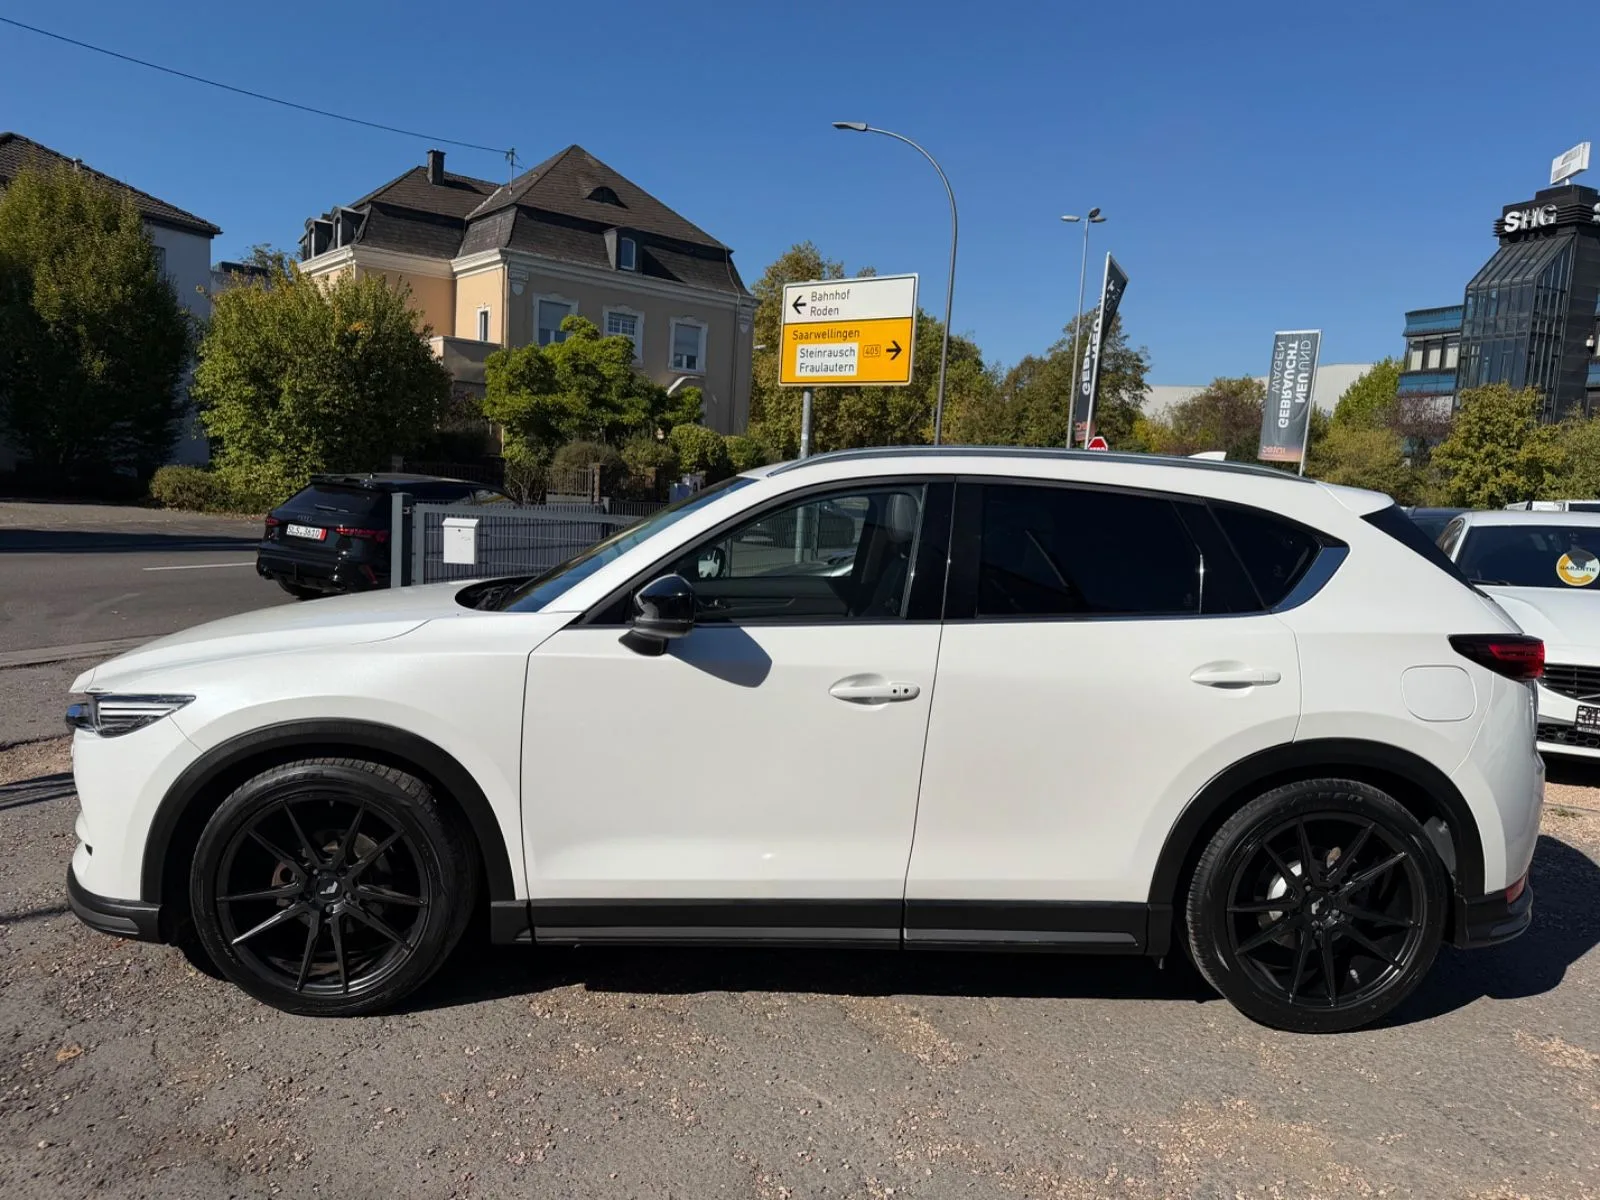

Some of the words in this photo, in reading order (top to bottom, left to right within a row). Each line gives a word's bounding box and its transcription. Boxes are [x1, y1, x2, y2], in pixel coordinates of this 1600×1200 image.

[1504, 204, 1557, 233] SHG
[811, 289, 850, 302] Bahnhof
[810, 306, 839, 316] Roden
[792, 328, 860, 341] Saarwellingen
[799, 346, 856, 359] Steinrausch
[865, 347, 879, 355] 405
[799, 362, 855, 373] Fraulautern
